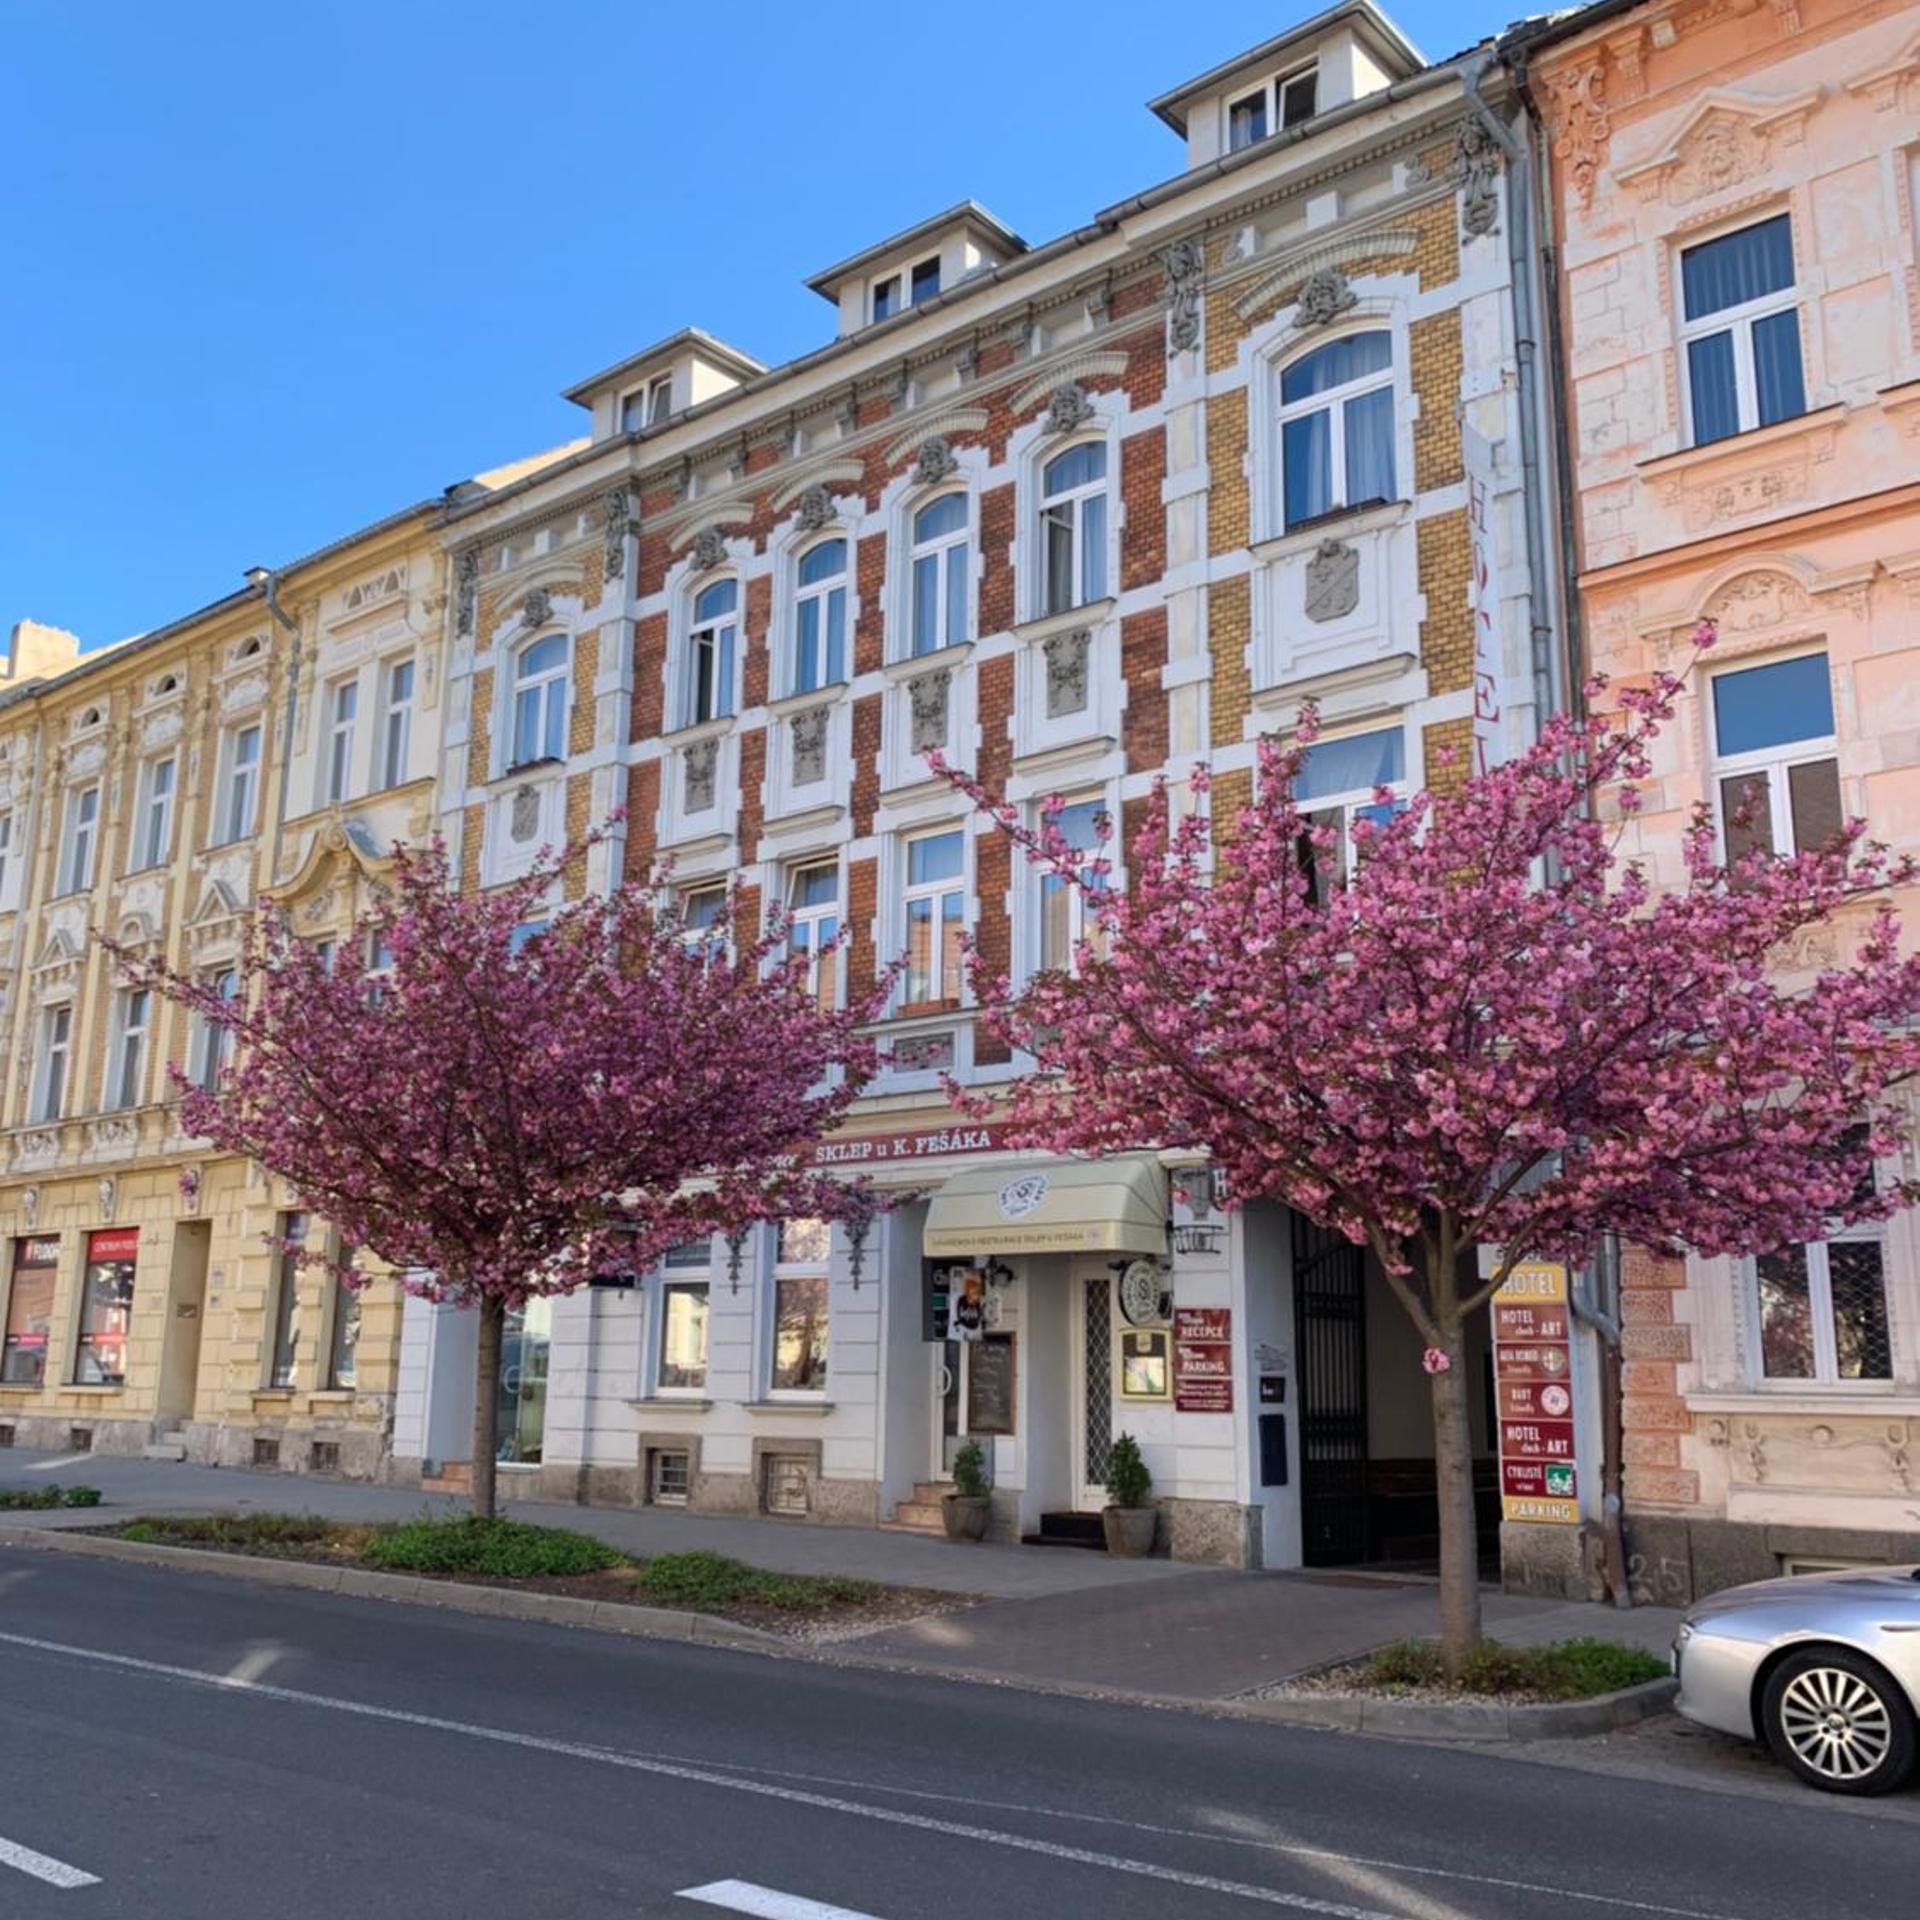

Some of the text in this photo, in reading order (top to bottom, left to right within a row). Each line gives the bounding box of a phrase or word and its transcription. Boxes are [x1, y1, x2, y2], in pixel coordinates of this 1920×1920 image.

[816, 1141, 872, 1163] SKLEP
[877, 1143, 887, 1157] u
[893, 1138, 912, 1156] K.
[915, 1128, 991, 1154] FEŠÁKA
[1503, 1272, 1556, 1296] HOTEL
[1501, 1309, 1534, 1324] HOTEL
[1541, 1321, 1561, 1336] ART
[1506, 1426, 1541, 1441] HOTEL
[1547, 1439, 1568, 1455] ART
[1511, 1501, 1570, 1519] PARKING
